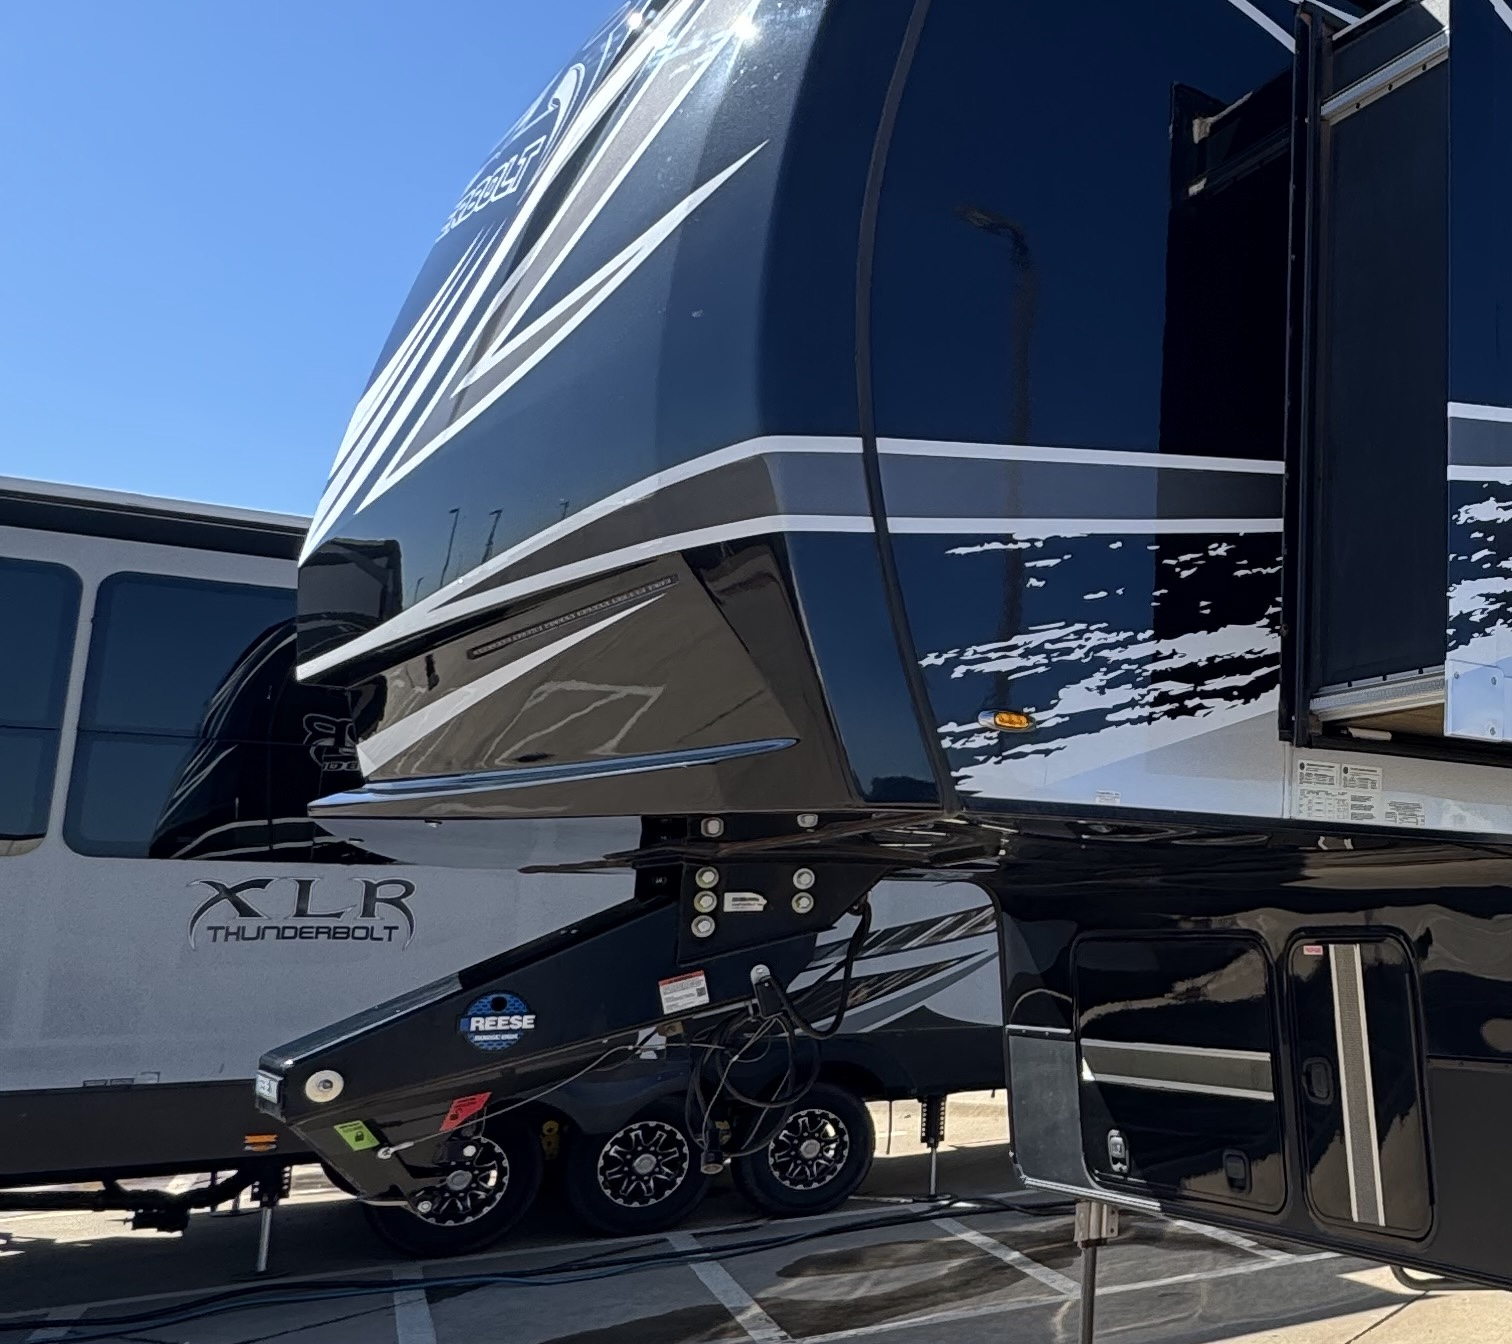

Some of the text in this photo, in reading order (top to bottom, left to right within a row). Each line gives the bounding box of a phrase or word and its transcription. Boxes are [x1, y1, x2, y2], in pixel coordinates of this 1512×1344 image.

[187, 876, 417, 952] XLR
[206, 925, 399, 943] THUNDERBOLT
[470, 1014, 536, 1032] REESE
